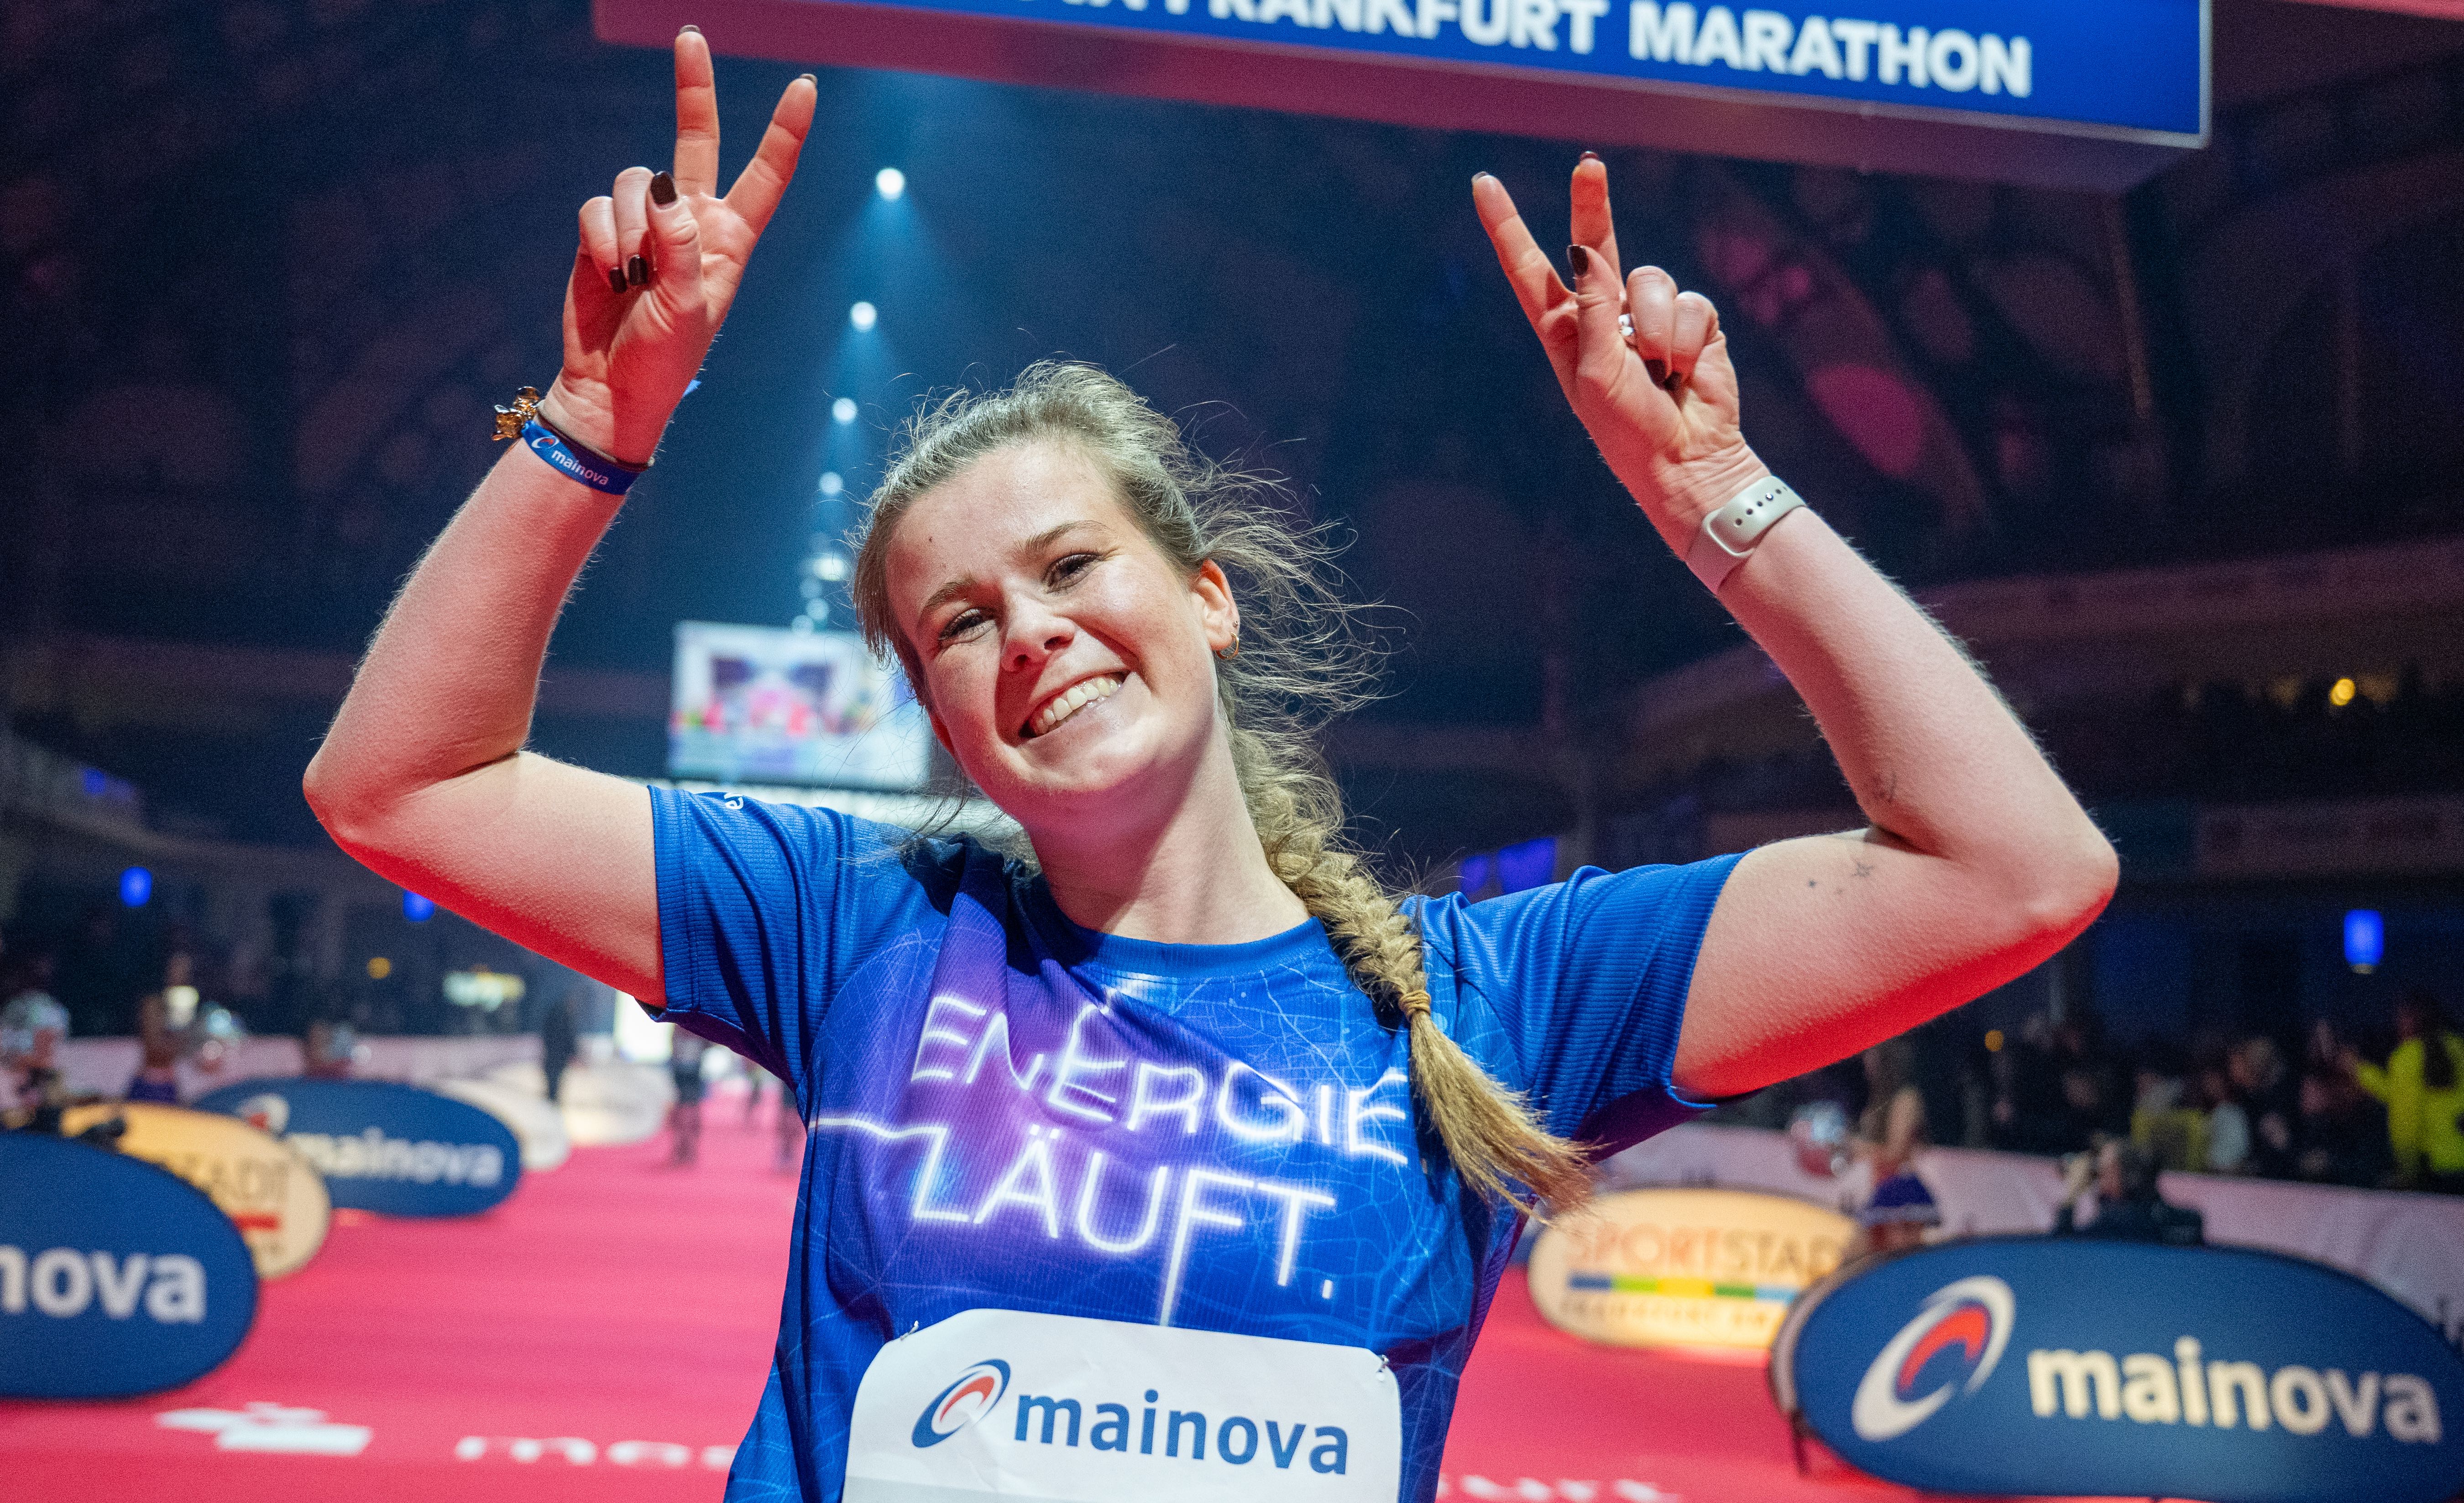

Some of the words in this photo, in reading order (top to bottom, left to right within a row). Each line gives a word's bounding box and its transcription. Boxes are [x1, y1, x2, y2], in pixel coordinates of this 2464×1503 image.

[1165, 0, 1610, 54] NKFURT
[1629, 0, 2032, 97] MARATHON
[551, 449, 609, 485] mainova
[911, 995, 1409, 1164] ENERGIE
[912, 1123, 1337, 1326] LÄUFT.
[1565, 1220, 1844, 1279] SPORTSTAD
[1013, 1388, 1349, 1476] mainova
[2026, 1335, 2443, 1444] mainova
